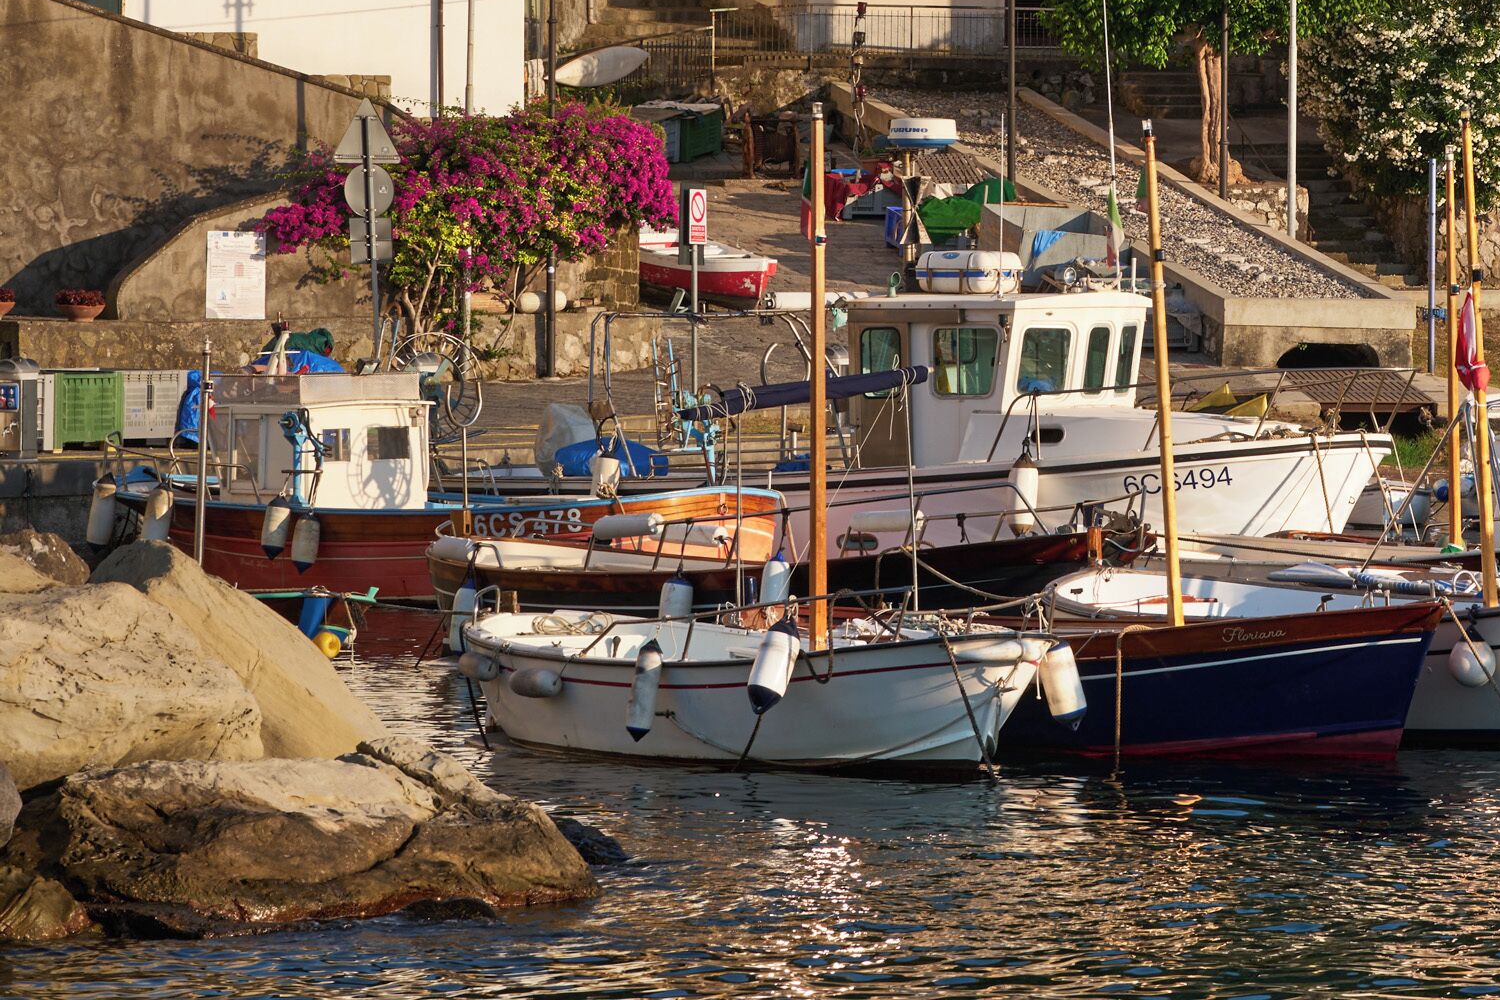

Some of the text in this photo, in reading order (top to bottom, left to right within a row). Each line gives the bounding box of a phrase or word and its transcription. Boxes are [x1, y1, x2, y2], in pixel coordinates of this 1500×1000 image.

[473, 508, 583, 538] 6CS 478
[1222, 627, 1287, 643] Floriana
